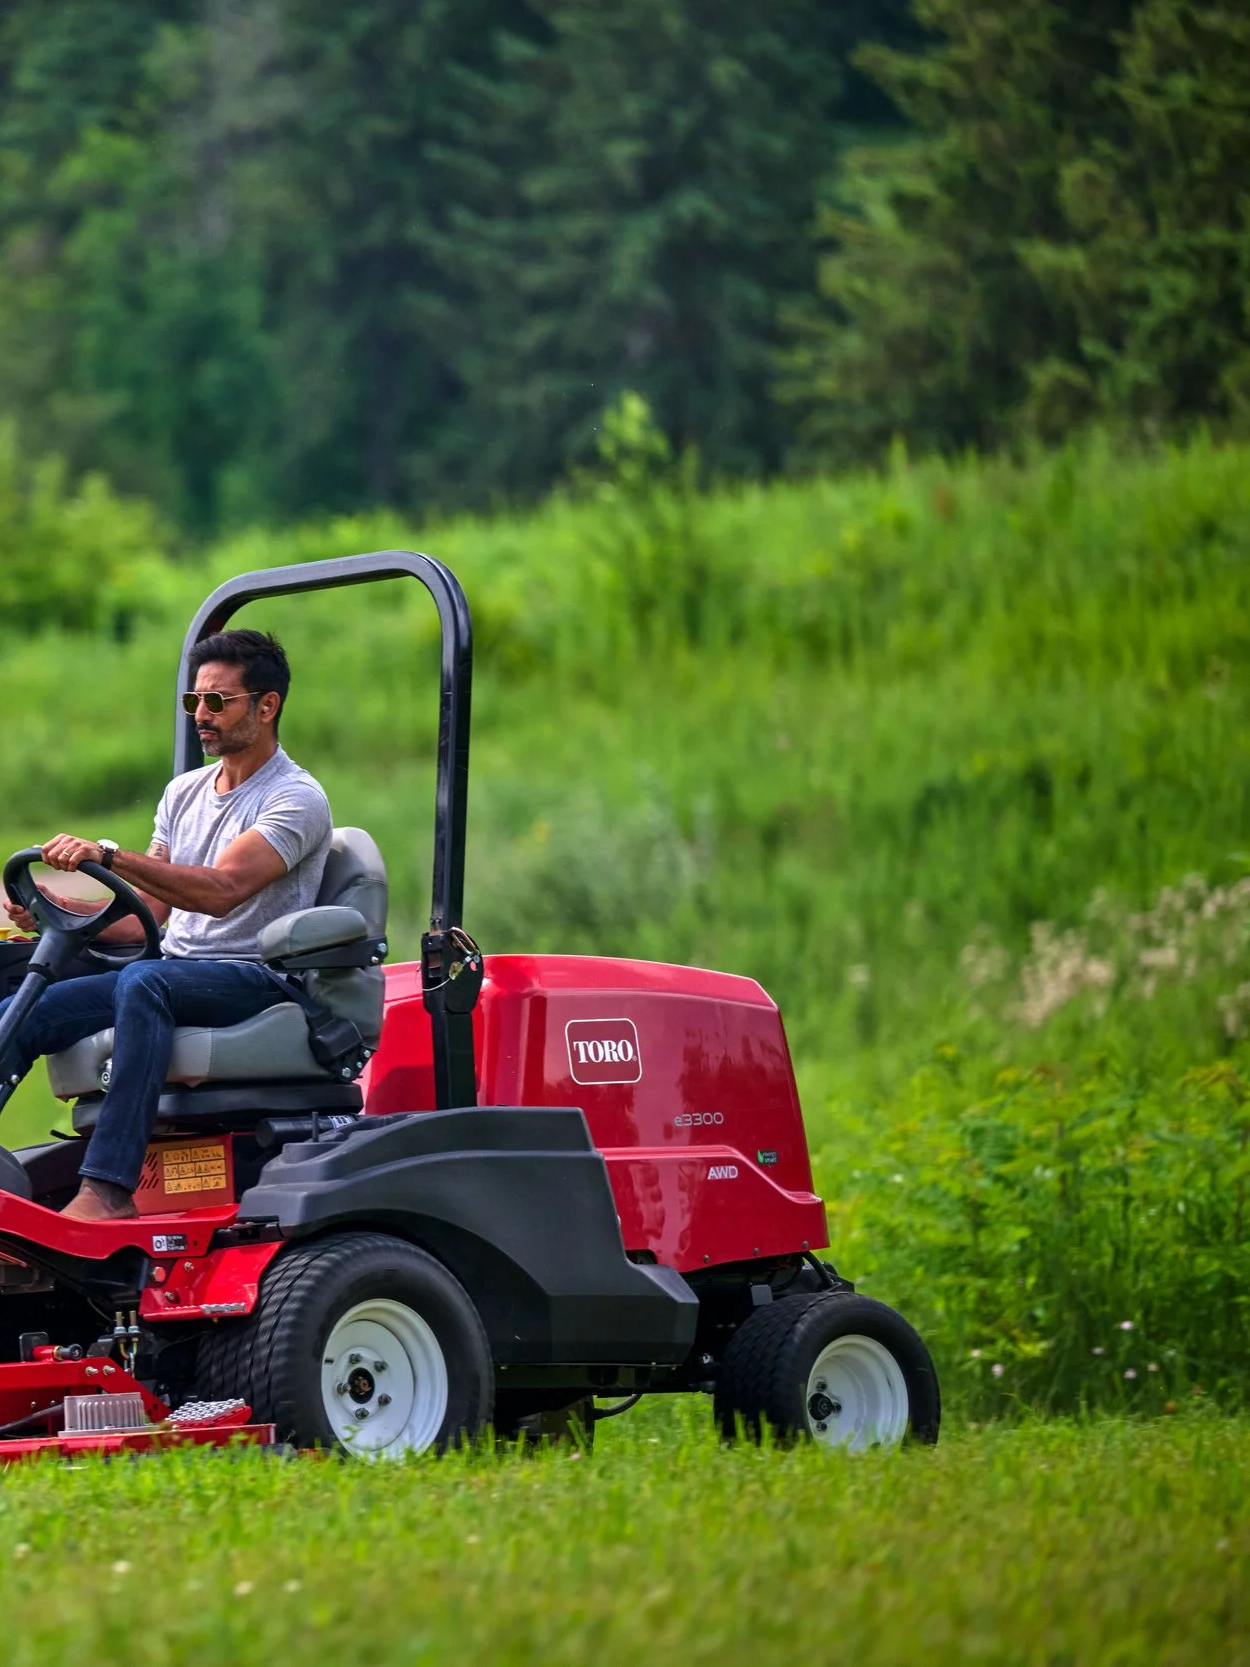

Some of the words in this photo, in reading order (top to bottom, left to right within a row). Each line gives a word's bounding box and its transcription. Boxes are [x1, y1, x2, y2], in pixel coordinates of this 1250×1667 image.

[573, 1039, 634, 1063] TORO
[674, 1112, 724, 1127] e3300
[707, 1165, 738, 1180] AWD
